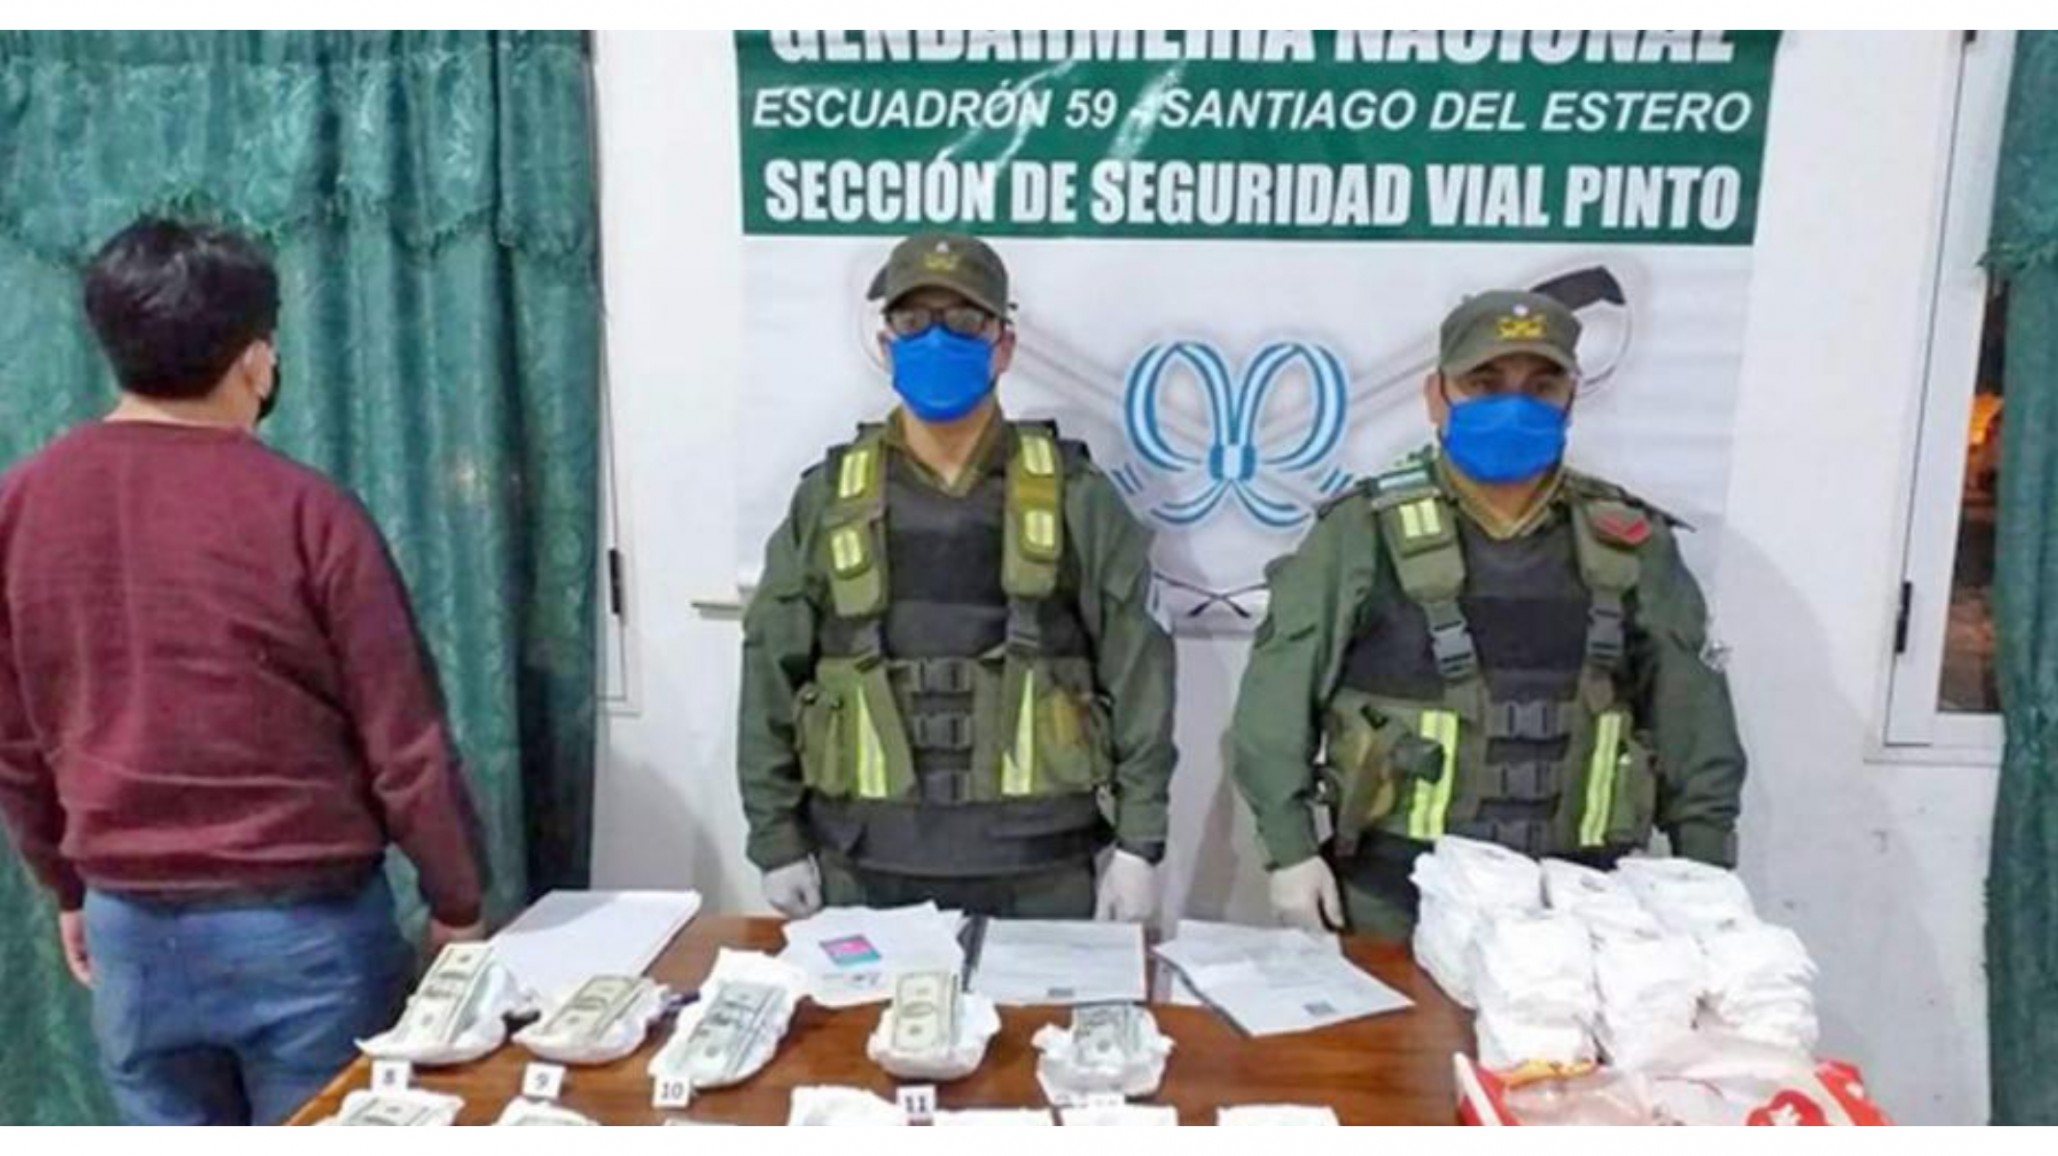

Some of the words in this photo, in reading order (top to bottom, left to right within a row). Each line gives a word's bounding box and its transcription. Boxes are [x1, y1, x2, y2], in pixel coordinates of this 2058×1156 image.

[752, 79, 1052, 128] ESCUADRÓN
[1065, 89, 1117, 128] 59
[1159, 88, 1418, 130] SANTIAGO
[1428, 90, 1527, 131] DEL
[1541, 90, 1753, 132] ESTERO
[764, 152, 996, 223] SECCIÓN
[1010, 160, 1078, 223] DE
[1090, 158, 1413, 226] SEGURIDAD
[1426, 163, 1550, 227] VIAL
[1563, 164, 1742, 231] PINTO
[660, 1081, 685, 1100] 10
